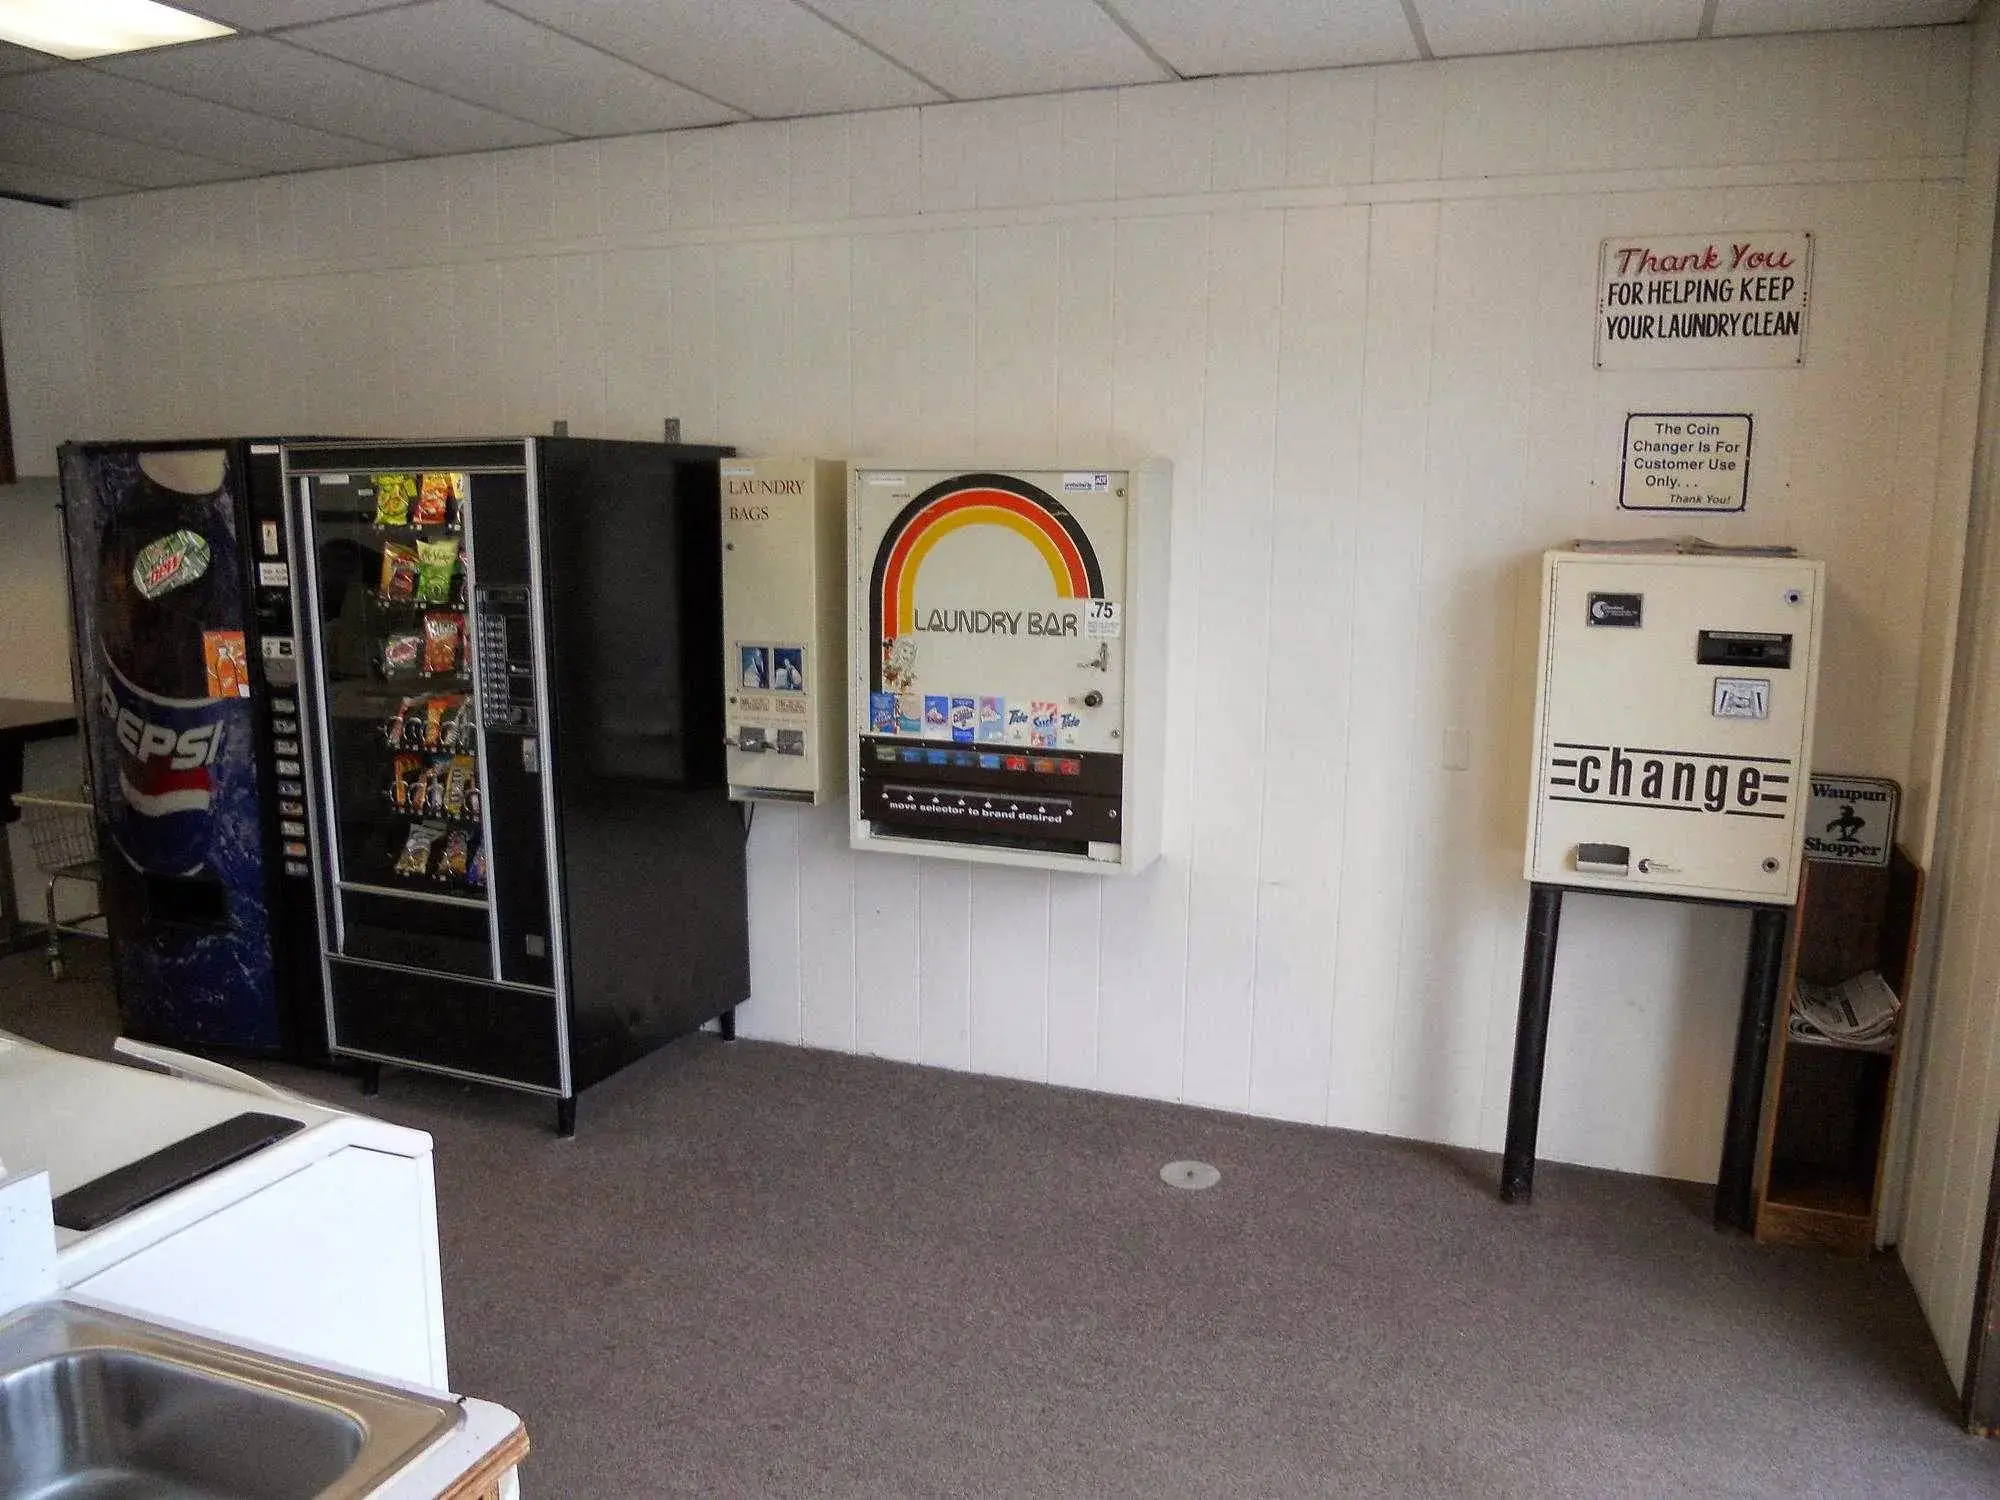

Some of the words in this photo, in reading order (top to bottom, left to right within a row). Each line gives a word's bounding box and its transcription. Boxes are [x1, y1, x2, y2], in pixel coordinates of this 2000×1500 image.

[1617, 244, 1723, 276] Thank
[1730, 243, 1797, 270] You
[1607, 281, 1644, 306] FOR
[1649, 277, 1735, 305] HELPING
[1740, 276, 1796, 302] KEEP
[1606, 315, 1655, 340] YOUR
[1657, 312, 1741, 339] LAUNDRY
[1742, 310, 1801, 338] CLEAN
[1655, 423, 1682, 435] The
[1686, 423, 1720, 435] Coin
[1633, 440, 1695, 455] Changer
[1698, 441, 1711, 453] Is
[1716, 441, 1741, 453] For
[1634, 457, 1705, 470] Customer
[1708, 459, 1736, 471] Use
[728, 479, 805, 495] LAUNDRY
[1669, 494, 1702, 504] Thank
[1706, 494, 1732, 505] You!
[728, 505, 770, 521] BAGS
[1090, 601, 1113, 620] .75
[913, 608, 1023, 636] LAUNDRY
[1027, 611, 1078, 637] BAR
[102, 680, 224, 770] PEPSI
[1008, 708, 1029, 726] Tide
[1032, 713, 1056, 728] Surf
[1060, 713, 1080, 729] Tide
[1577, 747, 1762, 814] change
[1811, 783, 1888, 803] Waupun
[889, 800, 917, 811] move
[919, 803, 965, 815] selector
[968, 806, 980, 816] to
[981, 808, 1016, 820] brand
[1018, 812, 1063, 824] desired
[1803, 836, 1882, 858] Shopper
